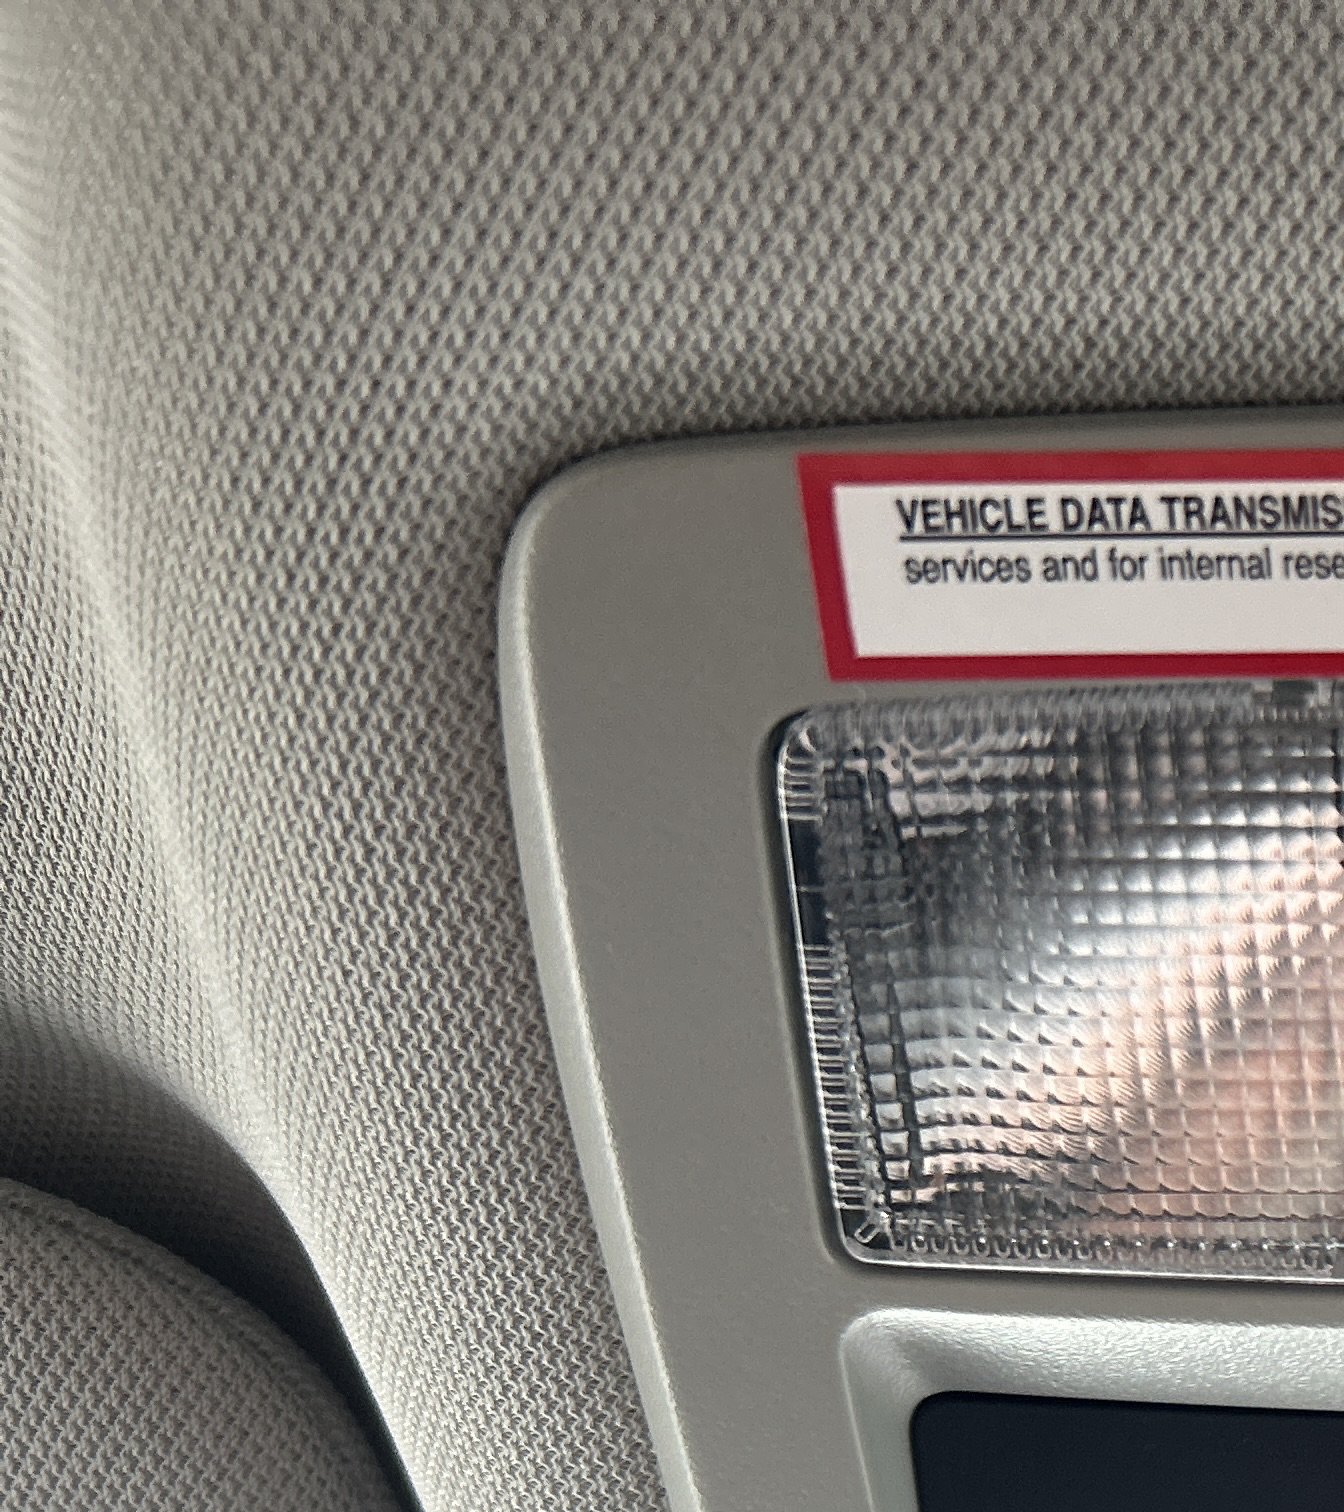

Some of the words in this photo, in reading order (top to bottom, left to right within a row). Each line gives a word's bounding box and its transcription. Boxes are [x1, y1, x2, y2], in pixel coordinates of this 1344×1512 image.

[895, 496, 1049, 532] VEHICLE
[1060, 495, 1152, 531] DATA
[903, 549, 1032, 585] services
[1041, 547, 1099, 583] and
[1107, 546, 1148, 582] for
[1158, 546, 1273, 581] internal
